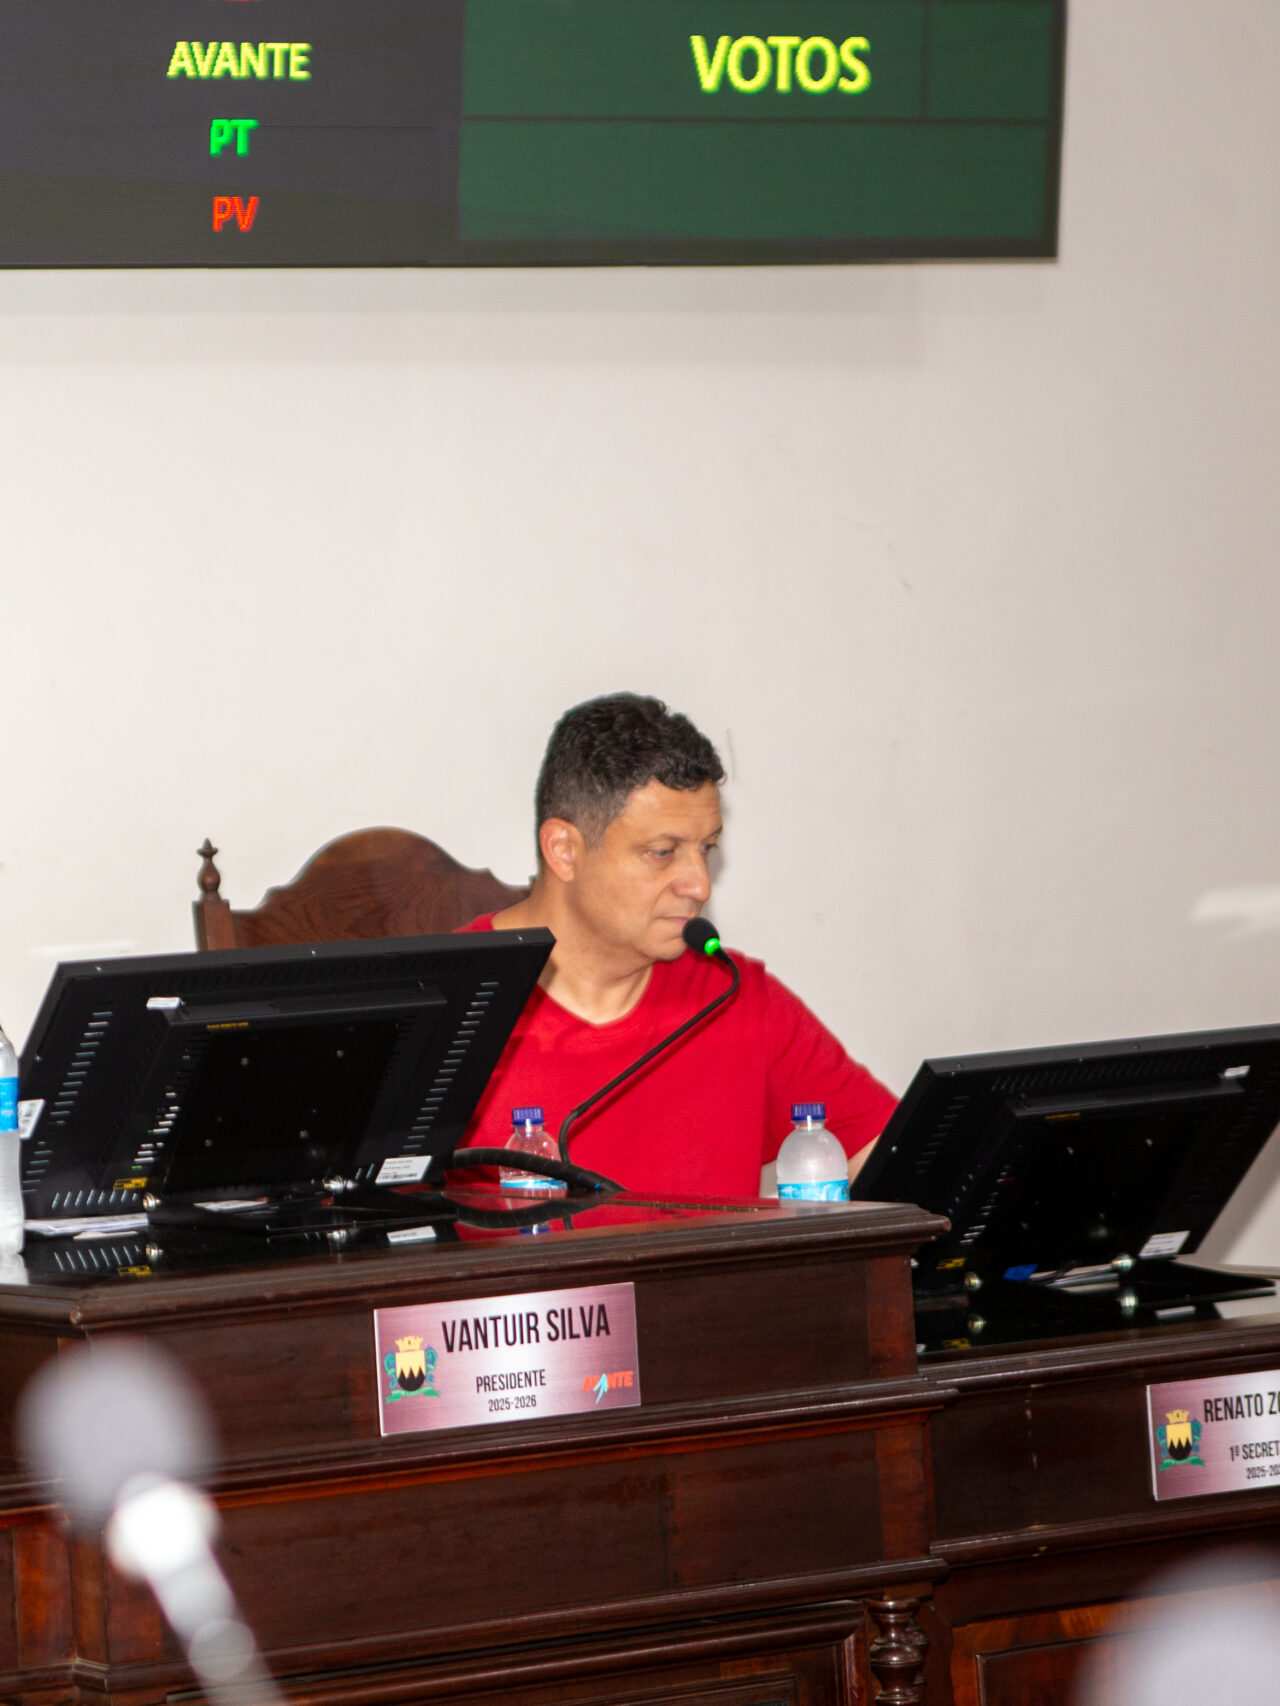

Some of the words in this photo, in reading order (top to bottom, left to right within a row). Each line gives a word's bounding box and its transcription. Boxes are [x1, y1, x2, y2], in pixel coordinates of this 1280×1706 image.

[166, 41, 312, 81] AVANTE
[689, 35, 871, 95] VOTOS
[209, 118, 259, 156] PT
[212, 195, 260, 232] PV
[441, 1311, 540, 1354] VANTUIR
[546, 1303, 611, 1342] SILVA
[476, 1369, 547, 1394] PRESIDENTE
[488, 1394, 537, 1412] 2025-2026
[1203, 1393, 1264, 1423] RENATO
